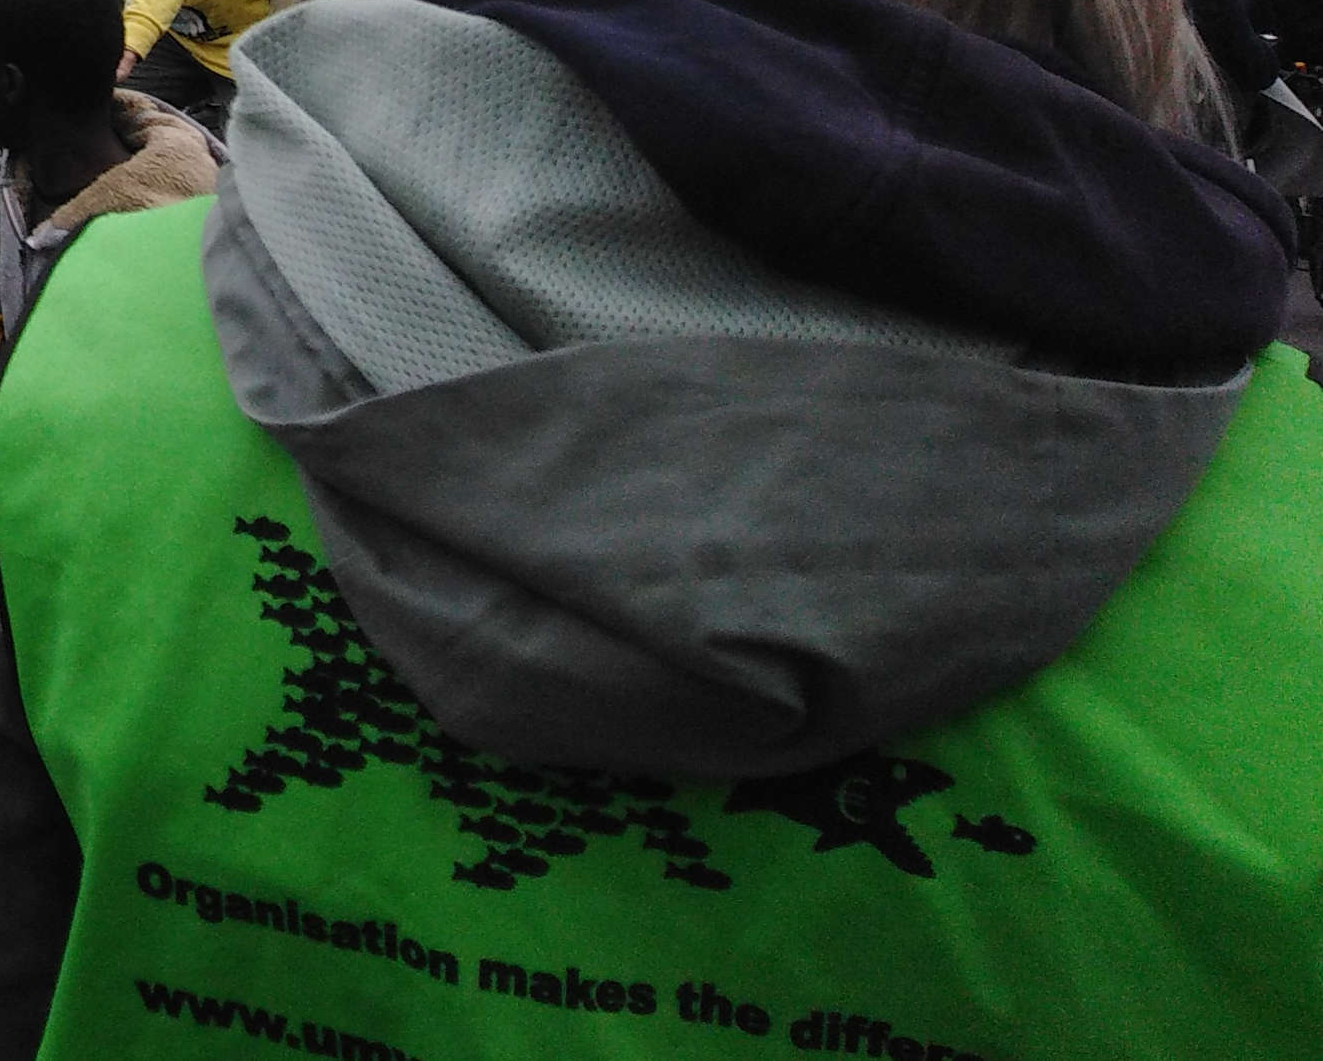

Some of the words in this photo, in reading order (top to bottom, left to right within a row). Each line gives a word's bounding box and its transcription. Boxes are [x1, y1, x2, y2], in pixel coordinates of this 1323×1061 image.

[137, 861, 460, 986] Organisation
[479, 957, 658, 1016] makes
[676, 981, 771, 1036] the
[134, 978, 424, 1061] www.um
